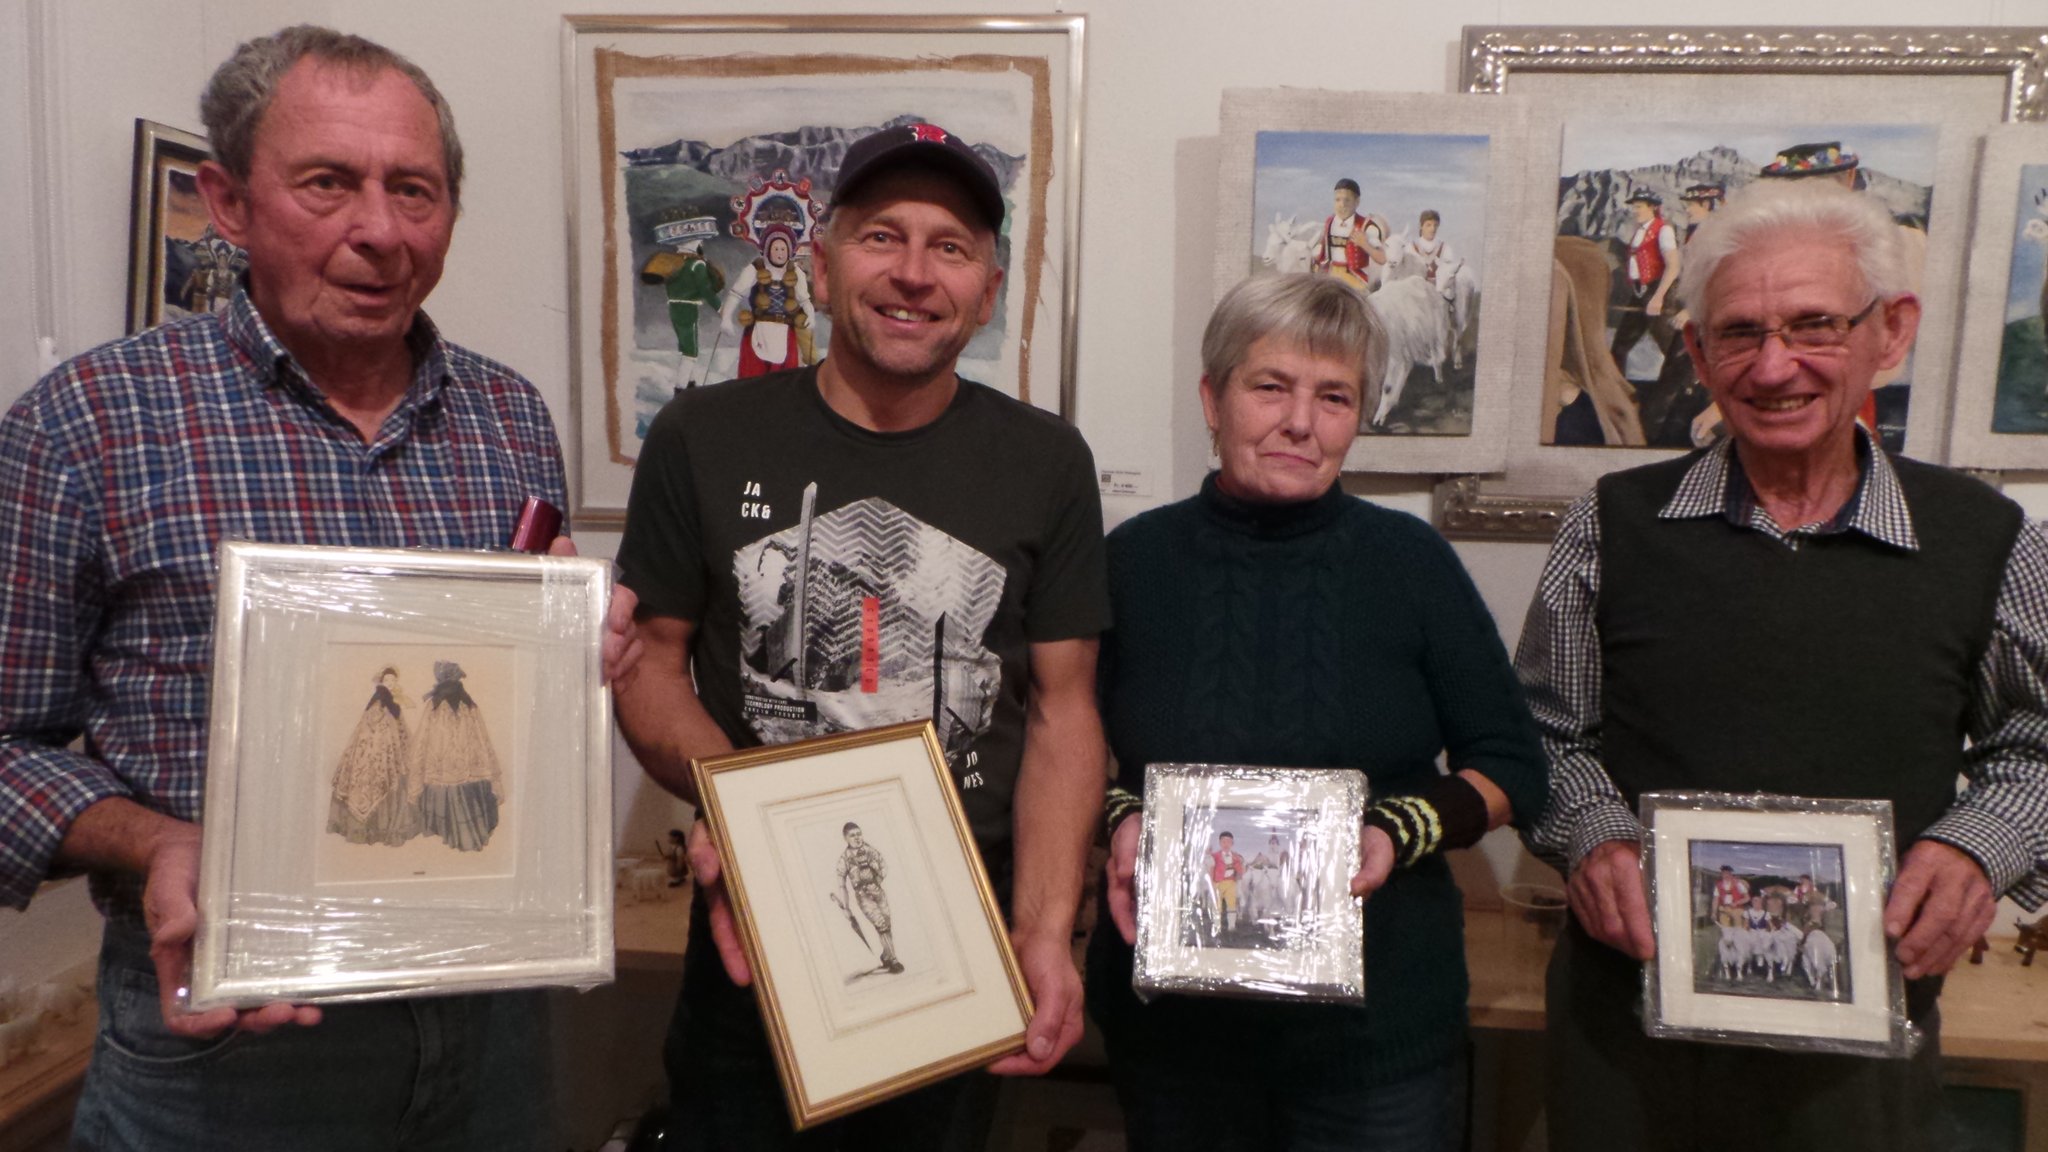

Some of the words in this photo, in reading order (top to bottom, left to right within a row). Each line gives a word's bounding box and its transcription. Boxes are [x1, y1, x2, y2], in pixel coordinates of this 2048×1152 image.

[743, 481, 761, 497] JA
[741, 502, 771, 519] CK&
[744, 699, 773, 710] TECHNOLOGY
[773, 704, 805, 713] PRODUCTION
[966, 751, 978, 768] JO
[963, 771, 984, 789] NES
